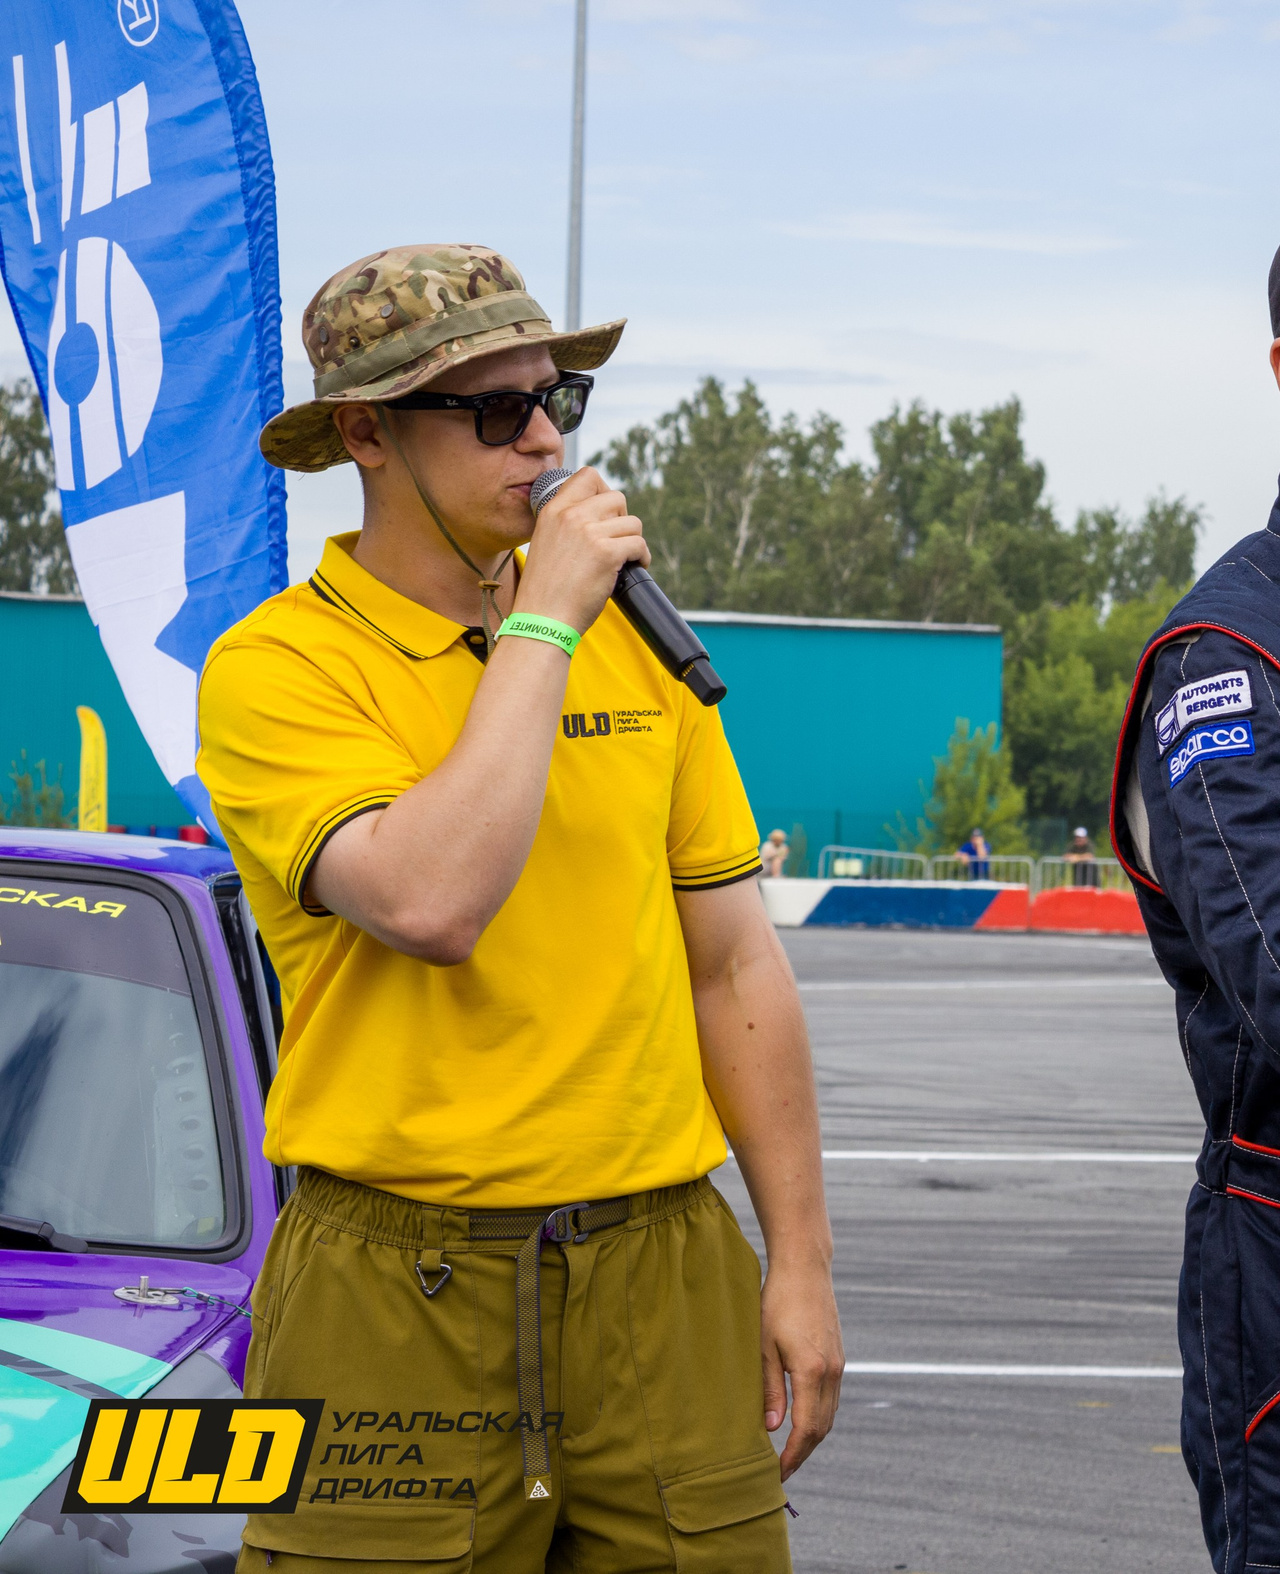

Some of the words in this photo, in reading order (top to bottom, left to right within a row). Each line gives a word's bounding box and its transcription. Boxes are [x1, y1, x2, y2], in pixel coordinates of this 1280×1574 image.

[509, 621, 572, 646] ОРГКОМИТЕТ
[1181, 677, 1244, 702] AUTOPARTS
[615, 710, 662, 718] УРАЛЬСКАЯ
[1186, 692, 1242, 716] BERGEYK
[562, 712, 611, 738] ULD
[618, 725, 653, 734] ДРИФТА
[1170, 726, 1249, 777] sparco
